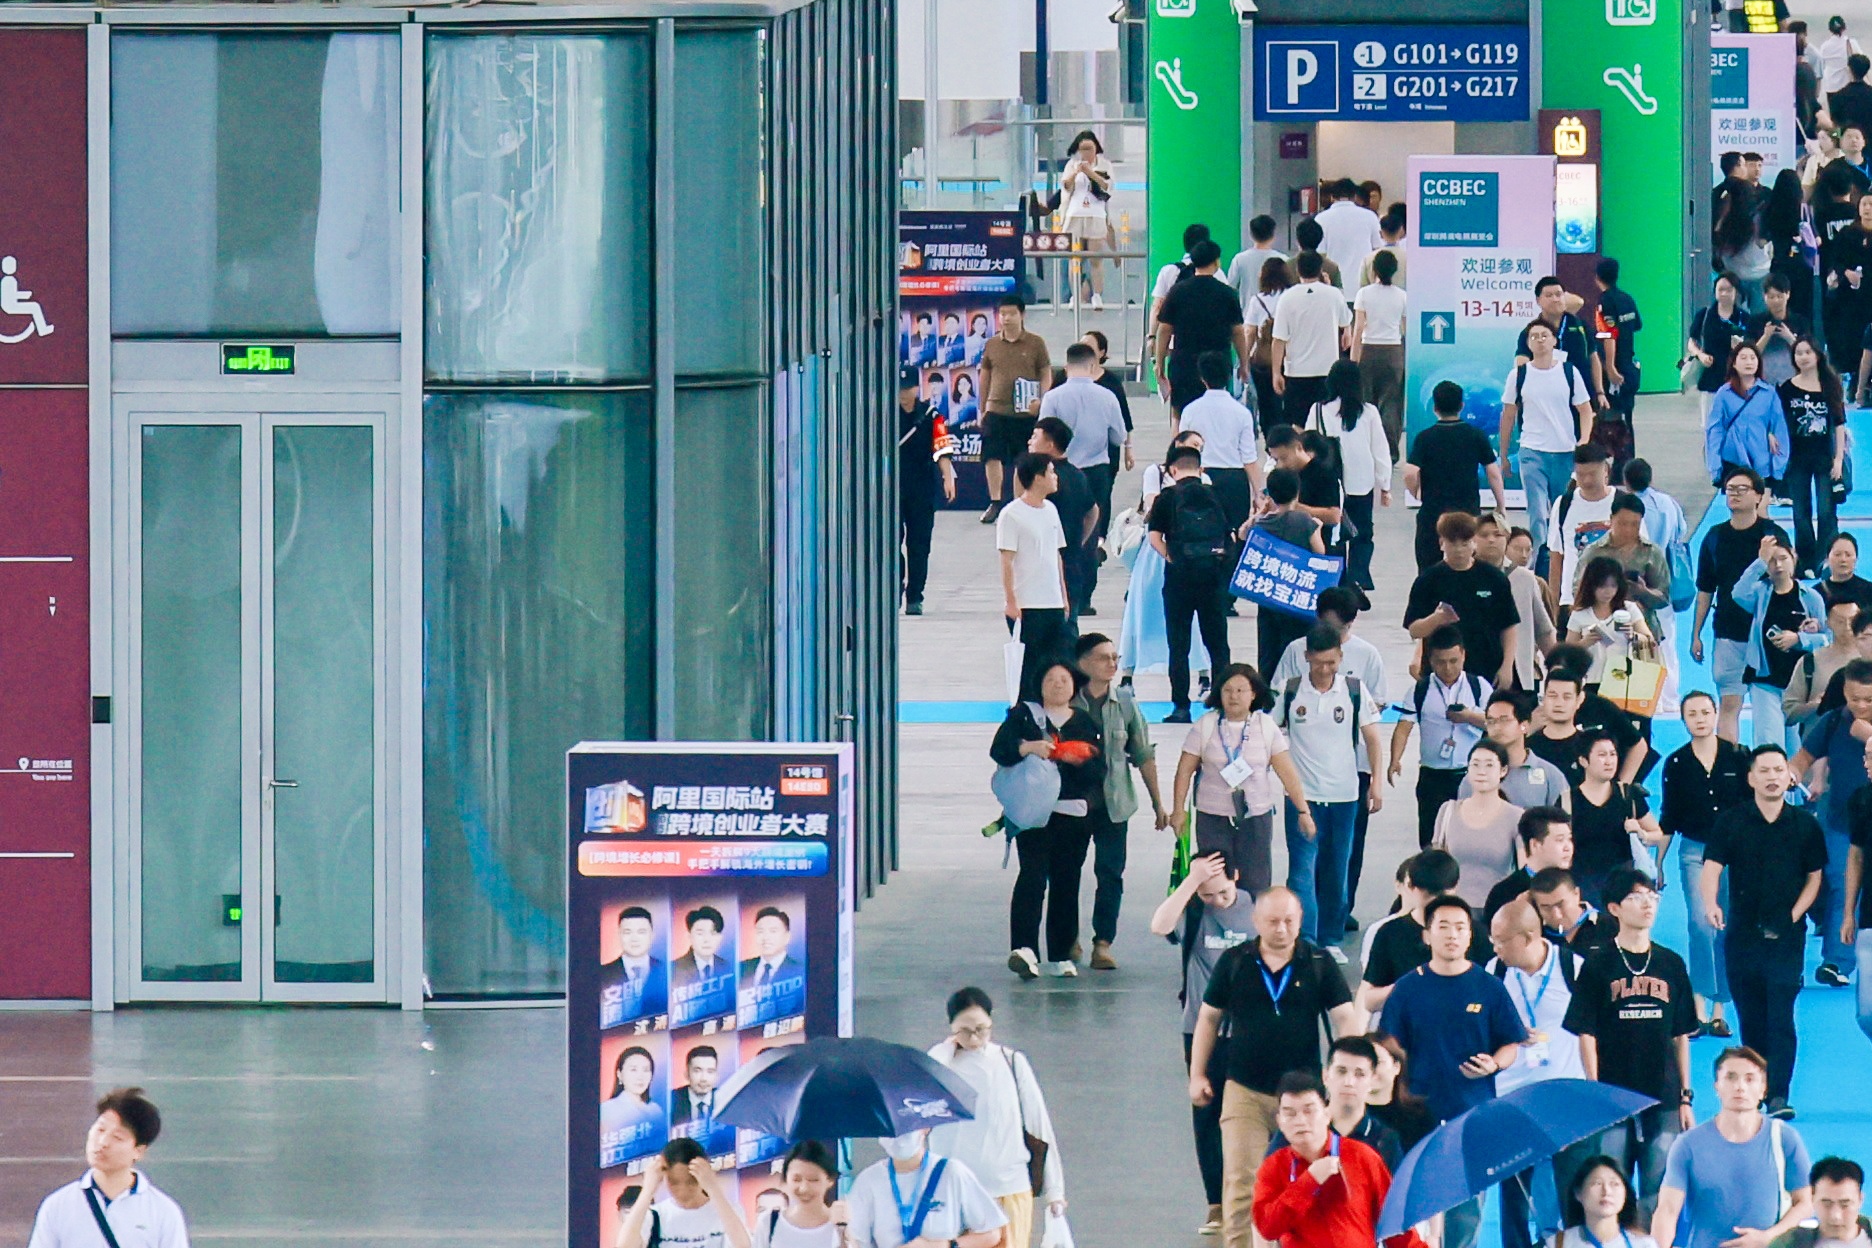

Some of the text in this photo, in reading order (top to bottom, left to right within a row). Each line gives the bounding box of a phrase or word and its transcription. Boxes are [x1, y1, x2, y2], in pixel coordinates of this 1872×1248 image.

[1394, 43, 1448, 65] G101
[1466, 43, 1519, 65] G119
[1287, 49, 1318, 104] P
[1357, 76, 1519, 97] -2 G201 G217
[1719, 118, 1777, 131] 欢迎参观
[1718, 134, 1778, 145] Welcome
[1423, 179, 1486, 196] CCBEC
[1424, 198, 1466, 206] SHENZHEN
[1461, 257, 1533, 274] 欢迎参观
[1461, 278, 1533, 290] Welcome
[1461, 300, 1514, 317] 13-14
[1243, 547, 1318, 589] 跨境物流
[652, 785, 775, 811] 阿里国际站
[666, 812, 829, 836] 跨境创业者大赛
[1609, 975, 1670, 1003] PLAYER
